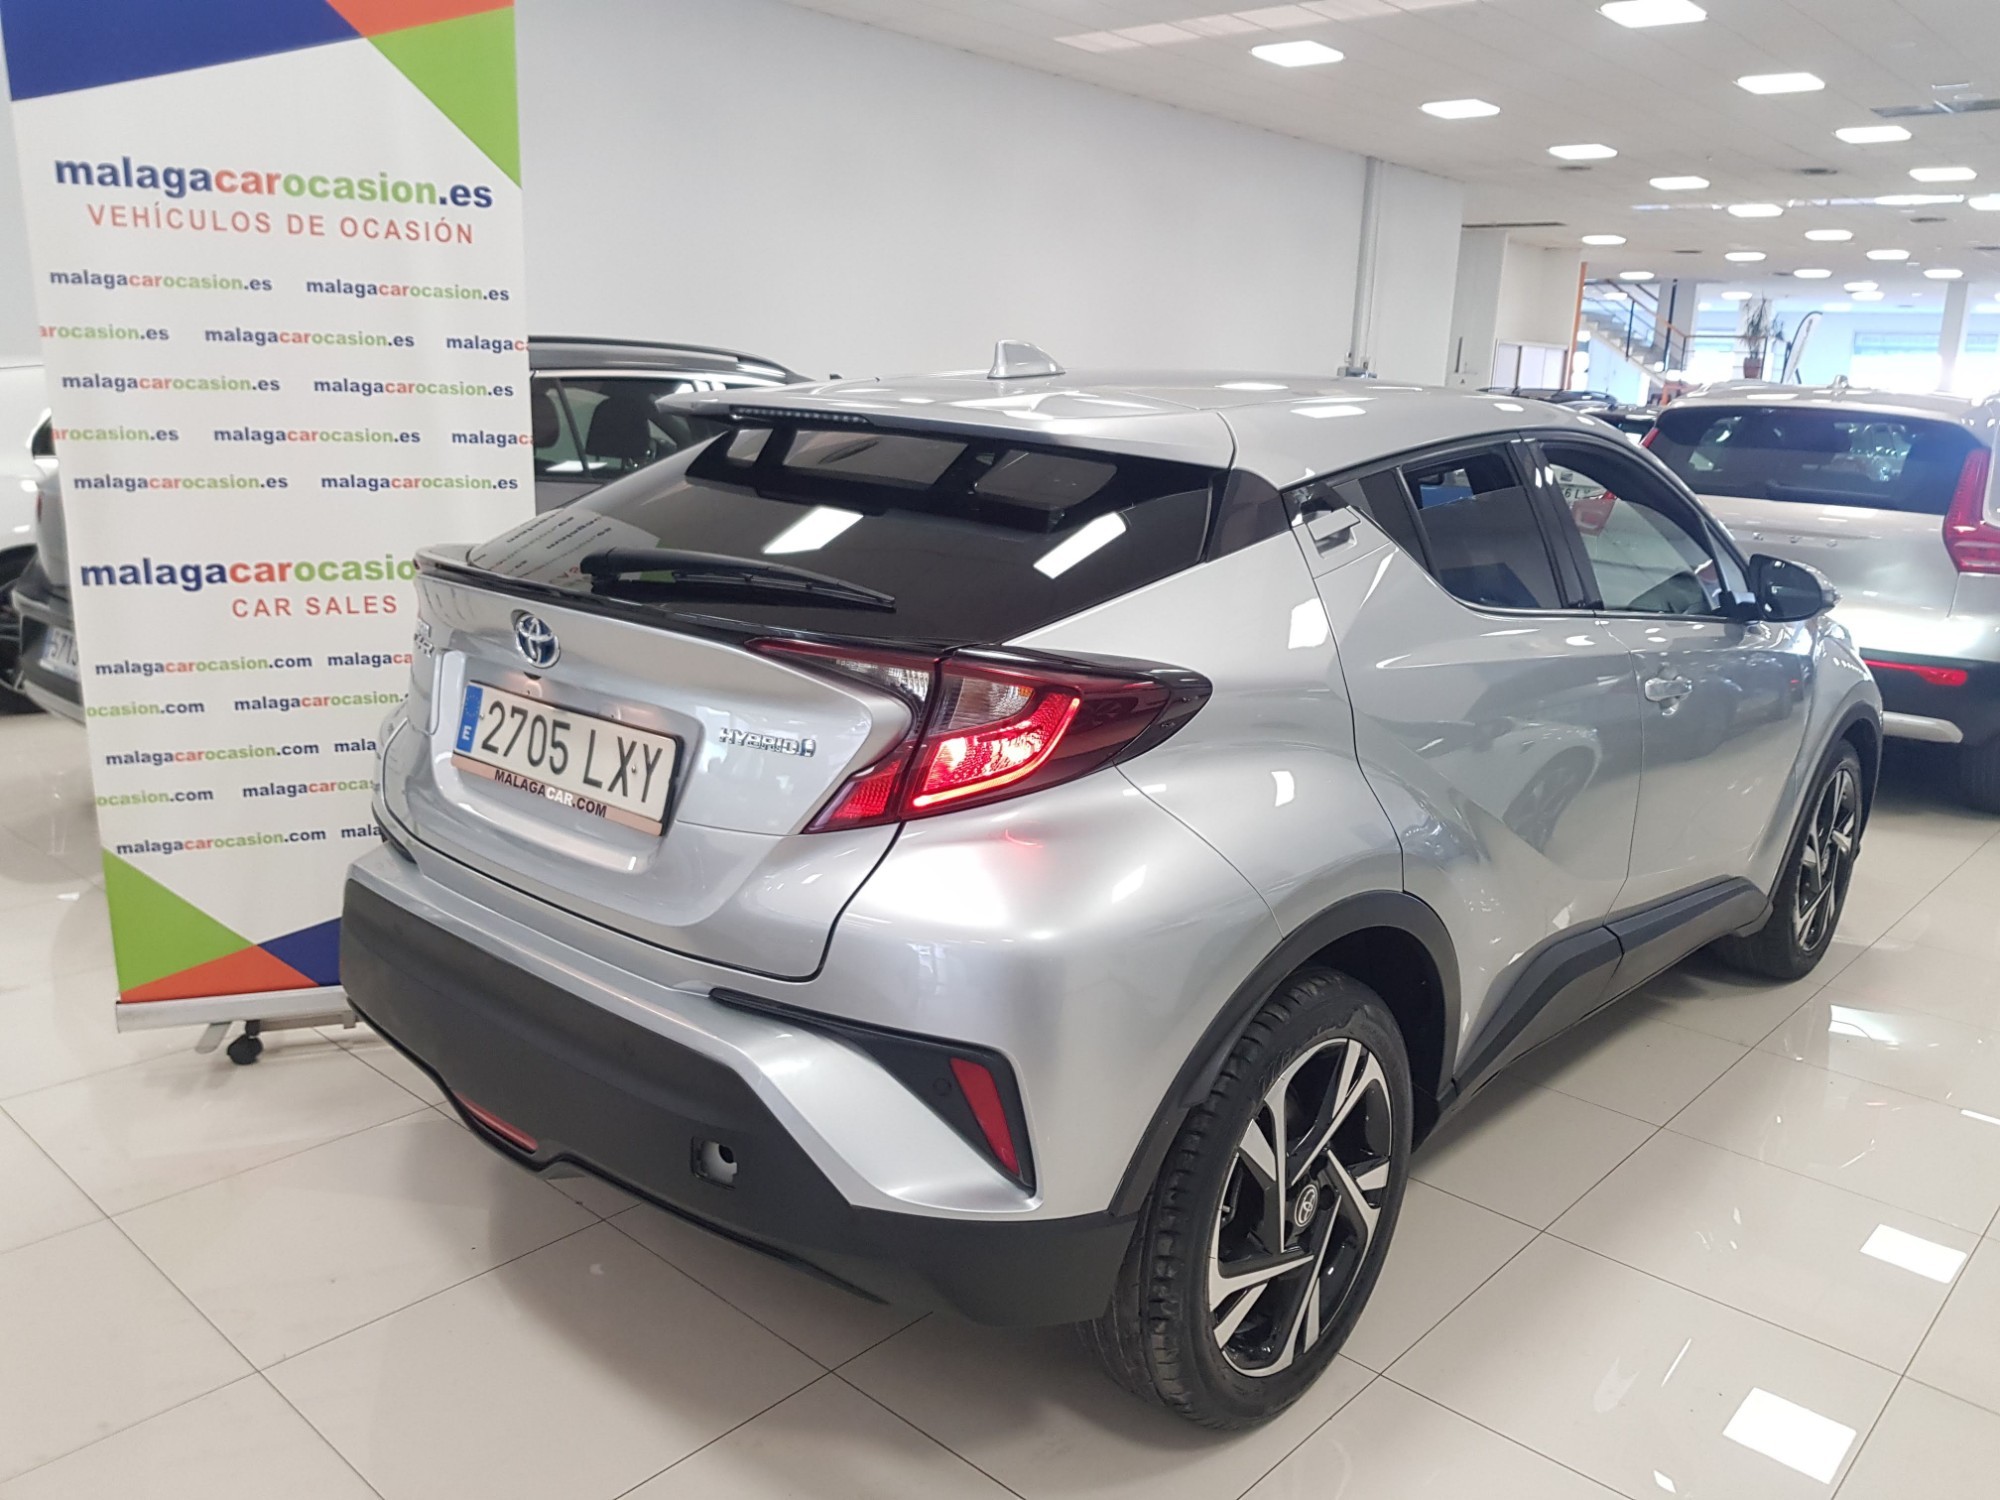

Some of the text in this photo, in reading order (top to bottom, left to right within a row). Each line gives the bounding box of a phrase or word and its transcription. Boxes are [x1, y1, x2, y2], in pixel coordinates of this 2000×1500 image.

[55, 156, 493, 208] malagacarocasion.es
[88, 202, 473, 245] VEHÍCULOS DE OCASIÓN
[50, 269, 272, 292] malagacarocasion.es
[306, 279, 510, 302] malagacarocasion.es
[205, 327, 415, 348] malagacarocasion.es
[446, 335, 529, 354] malagac
[62, 373, 280, 393] malagacarocasion.es
[314, 378, 514, 398] malagacarocasion.es
[214, 427, 420, 446] malagacarocasion.es
[74, 474, 288, 493] malagacarocasion.es
[321, 474, 518, 493] malagacarocasion.es
[232, 595, 398, 618] CAR SALES
[95, 656, 312, 678] malagacarocasion.com
[86, 701, 205, 719] ocasion.com
[461, 725, 472, 742] E
[719, 727, 799, 755] HYBRID
[106, 743, 319, 767] malagacarocasion.com
[481, 700, 664, 804] 2705 LXY
[494, 769, 608, 819] MALAGACAR.COM
[116, 829, 326, 856] malagacarocasion.com
